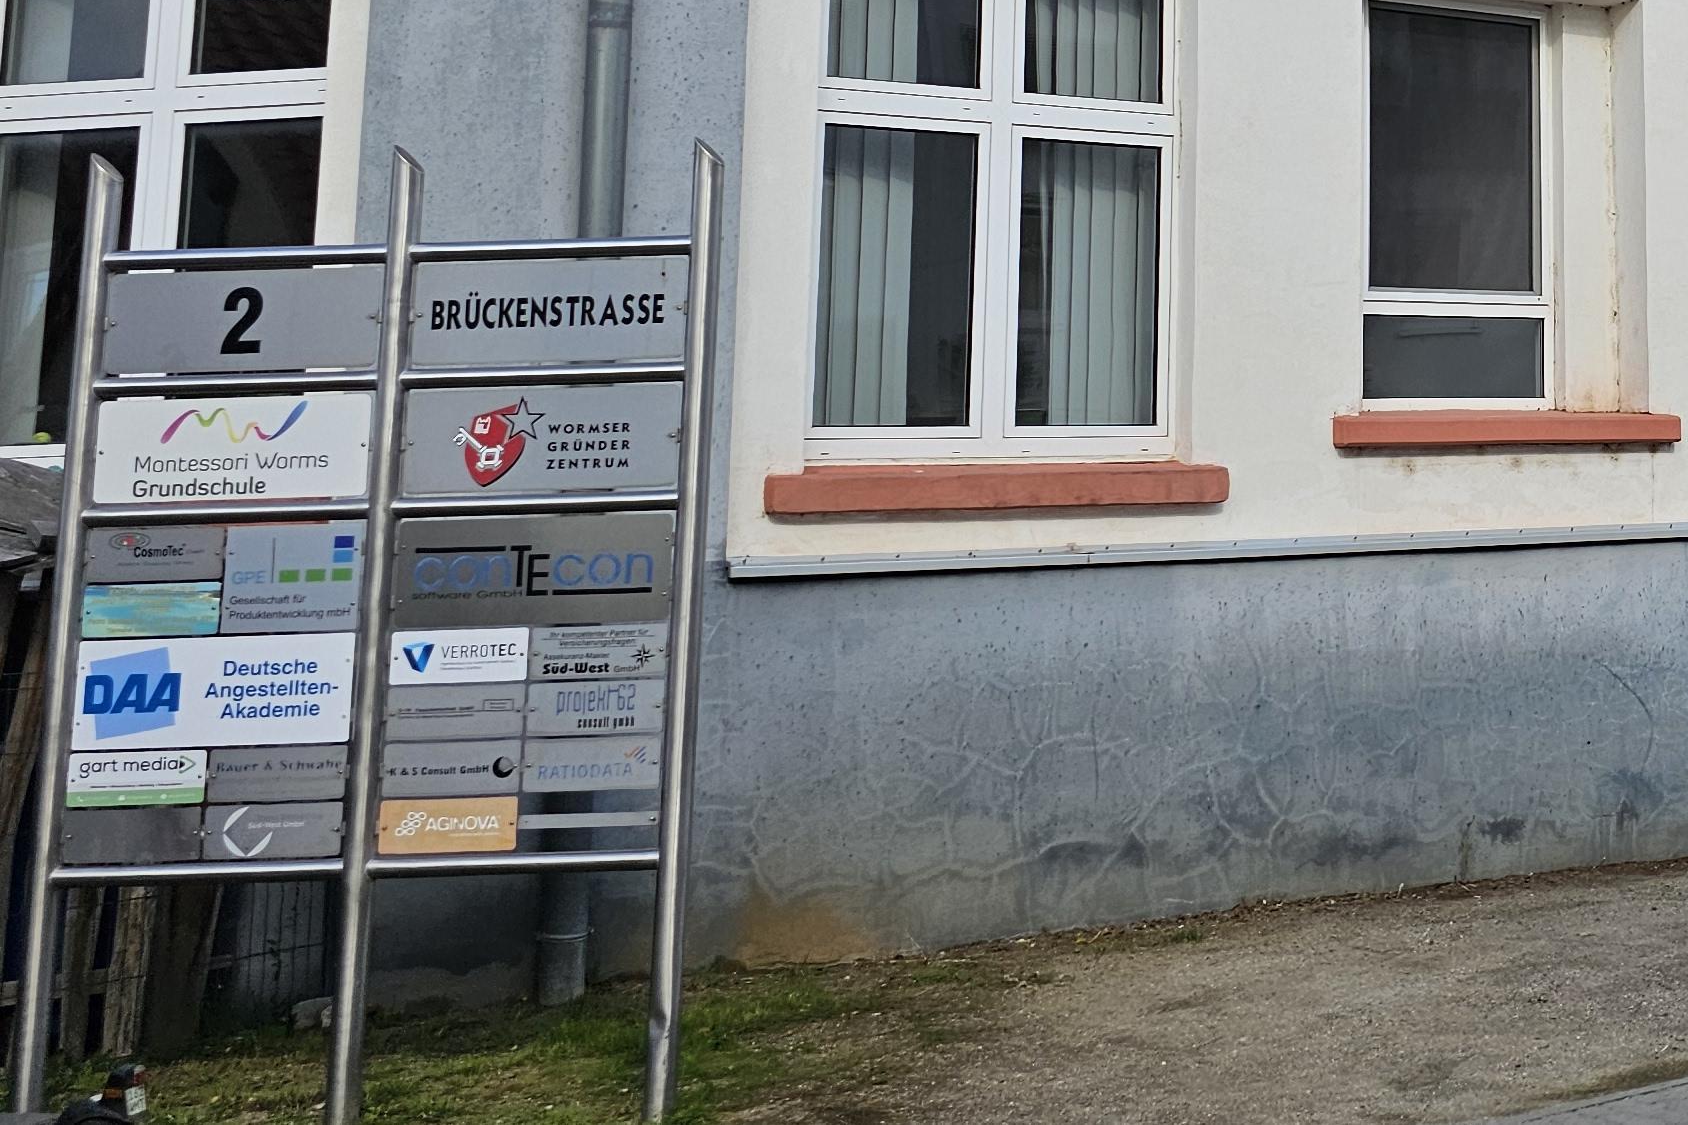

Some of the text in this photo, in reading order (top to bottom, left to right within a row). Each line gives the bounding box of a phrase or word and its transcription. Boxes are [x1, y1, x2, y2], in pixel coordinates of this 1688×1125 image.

[430, 291, 665, 331] BRÜCKENSTRASSE
[219, 286, 264, 355] 2
[548, 422, 631, 435] WORMSER
[547, 438, 631, 452] GRÜNDER
[134, 451, 329, 473] Montessori Worms
[546, 457, 630, 470] ZENTRUM
[132, 476, 266, 498] Grundschule
[133, 545, 184, 558] CosmoTec
[231, 570, 267, 585] GPE
[229, 594, 290, 605] Gesellschaft
[411, 589, 523, 600] software GmbH
[228, 608, 324, 620] Produktentwicklung
[327, 607, 352, 617] mbH
[441, 643, 518, 659] VERROTEC
[223, 659, 318, 677] Deutsche
[542, 662, 610, 675] Süd-West
[82, 672, 182, 715] DAA
[204, 679, 340, 701] Angestellten-
[220, 701, 321, 720] Akademie
[79, 756, 179, 779] gart media
[421, 766, 457, 776] Consult
[460, 764, 490, 775] GmbH
[425, 815, 500, 832] AGINOVA
